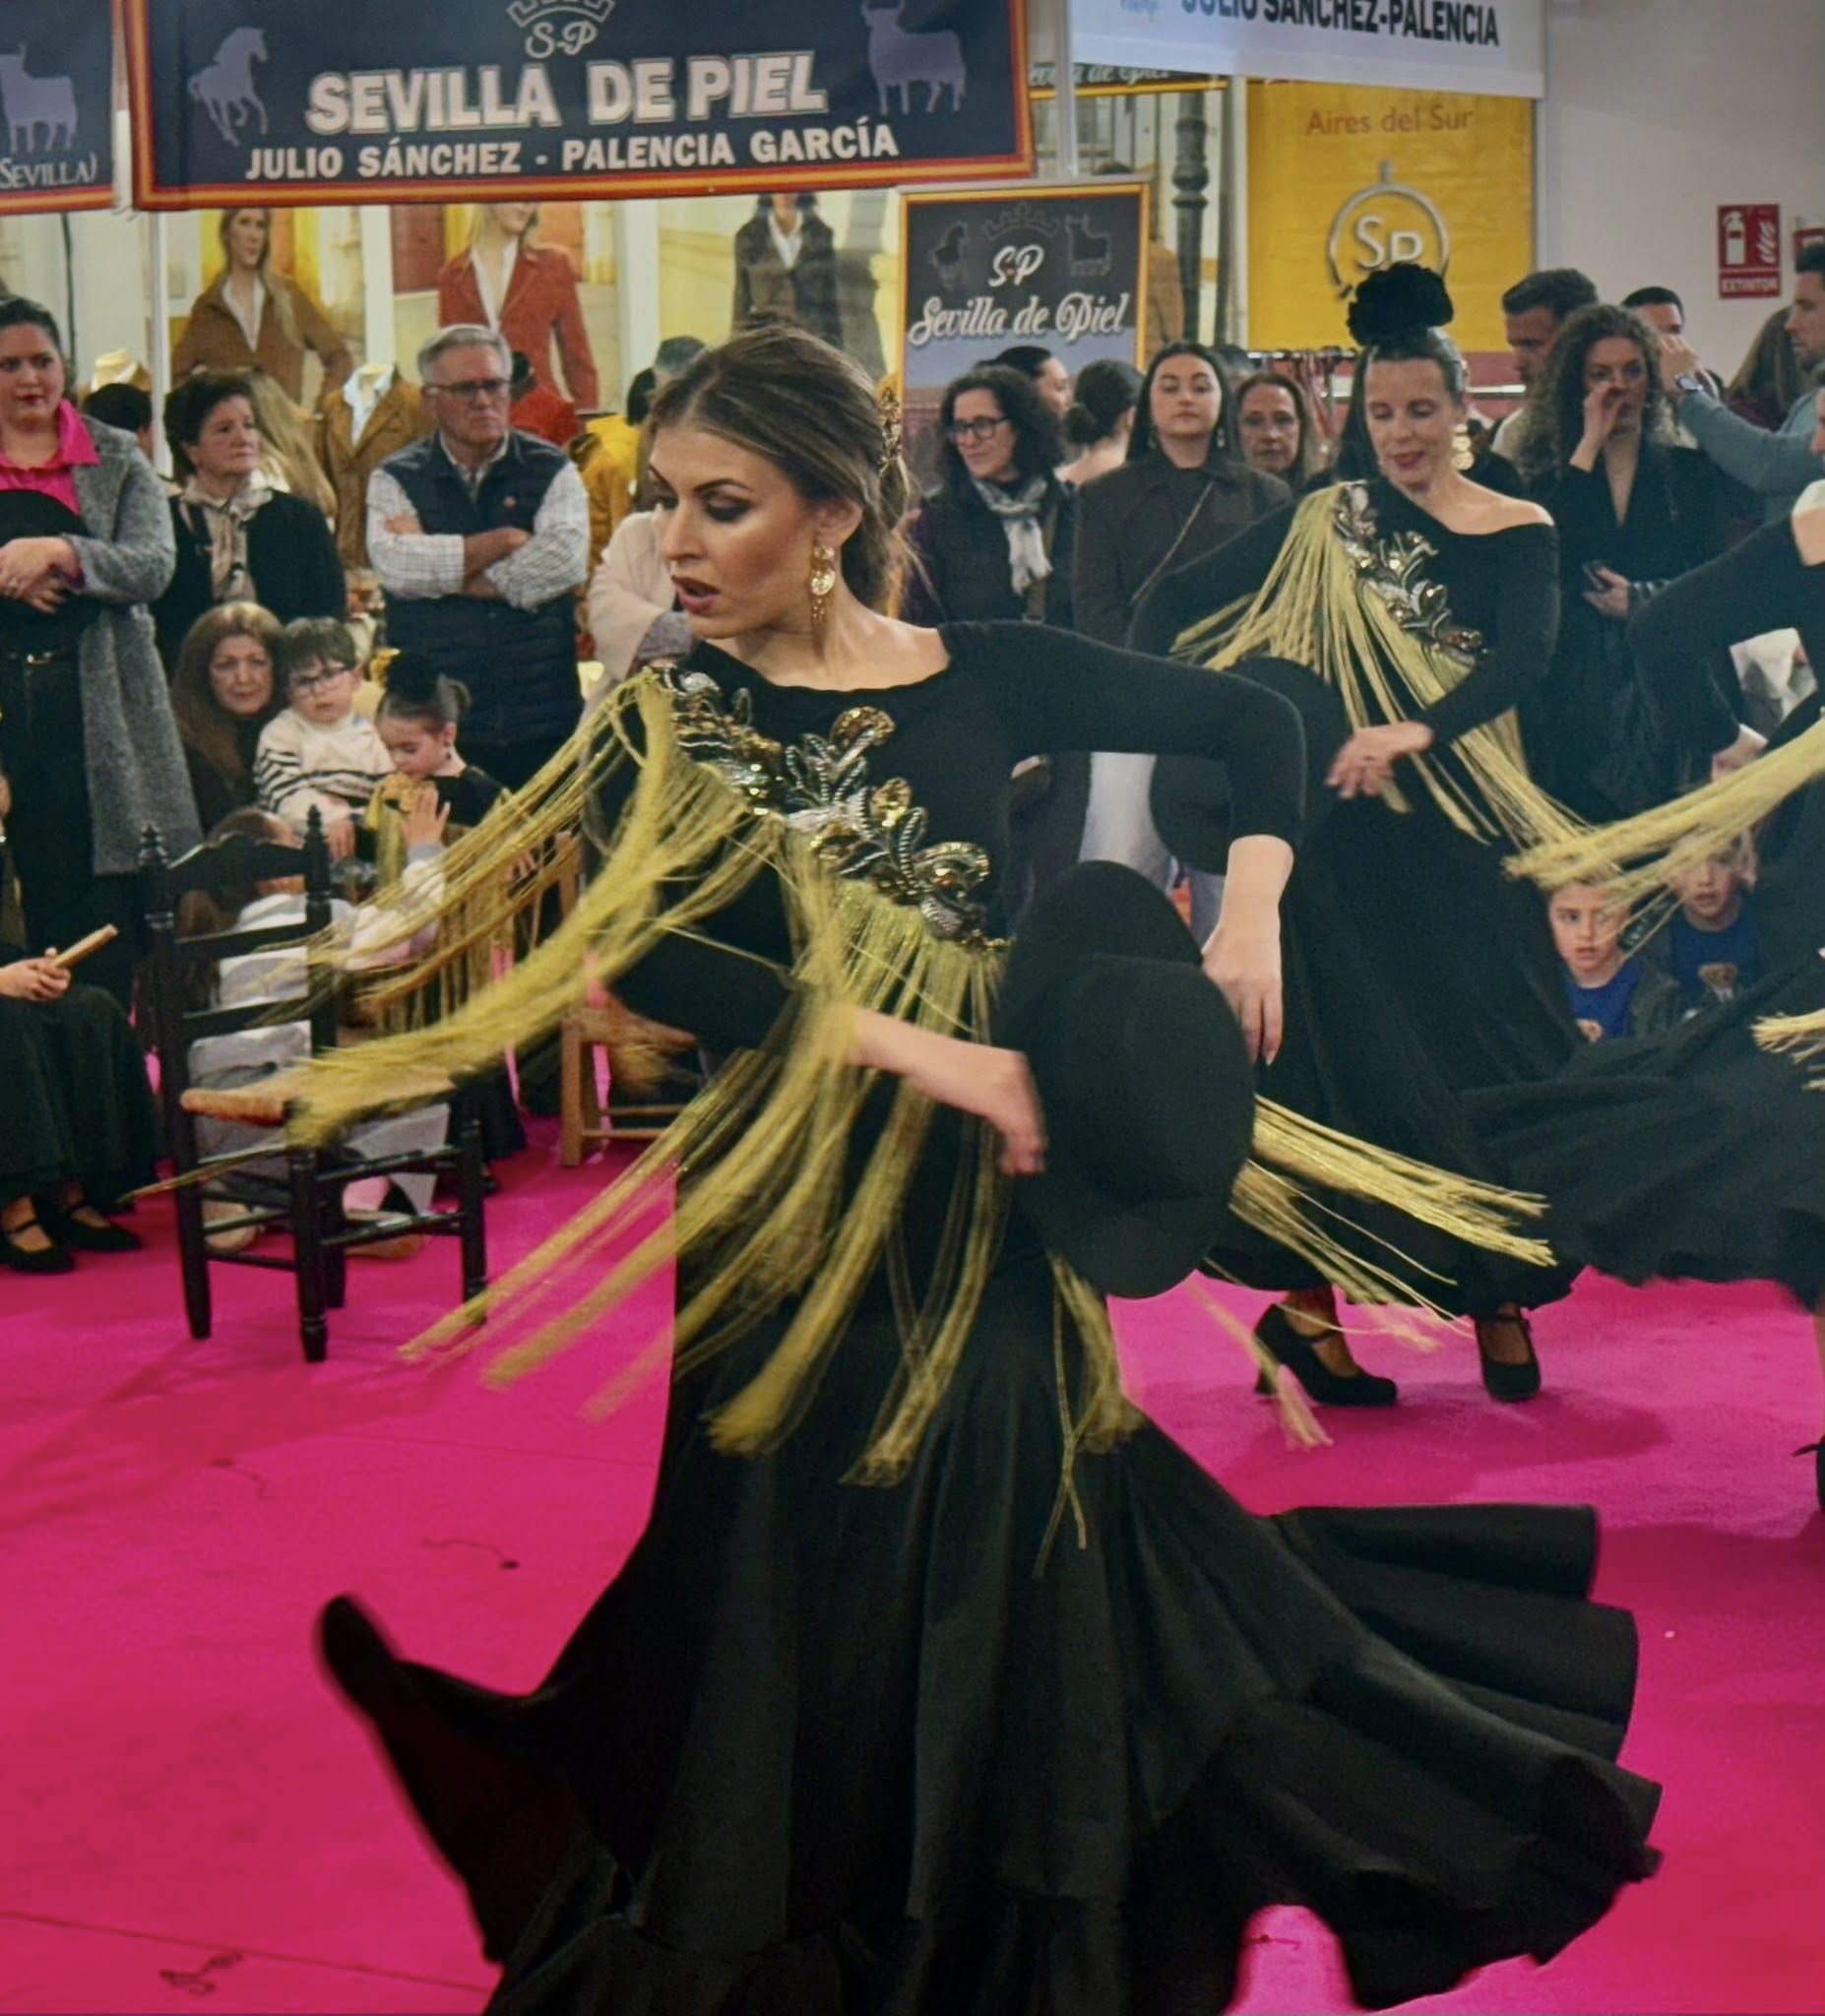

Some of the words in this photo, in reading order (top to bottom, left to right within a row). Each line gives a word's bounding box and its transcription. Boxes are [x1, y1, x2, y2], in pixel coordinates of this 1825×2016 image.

[305, 62, 563, 136] SEVILLA
[587, 57, 675, 126] DE
[686, 50, 829, 122] PIEL
[1305, 109, 1372, 136] Aires
[1381, 106, 1420, 134] del
[1429, 104, 1474, 131] Sur
[245, 147, 343, 180] JULIO
[356, 137, 521, 178] SÁNCHEZ
[562, 131, 735, 171] PALENCIA
[749, 114, 900, 163] GARCÍA
[908, 296, 1008, 346] Sevilla
[1012, 295, 1048, 336] de
[1054, 291, 1130, 342] Piel
